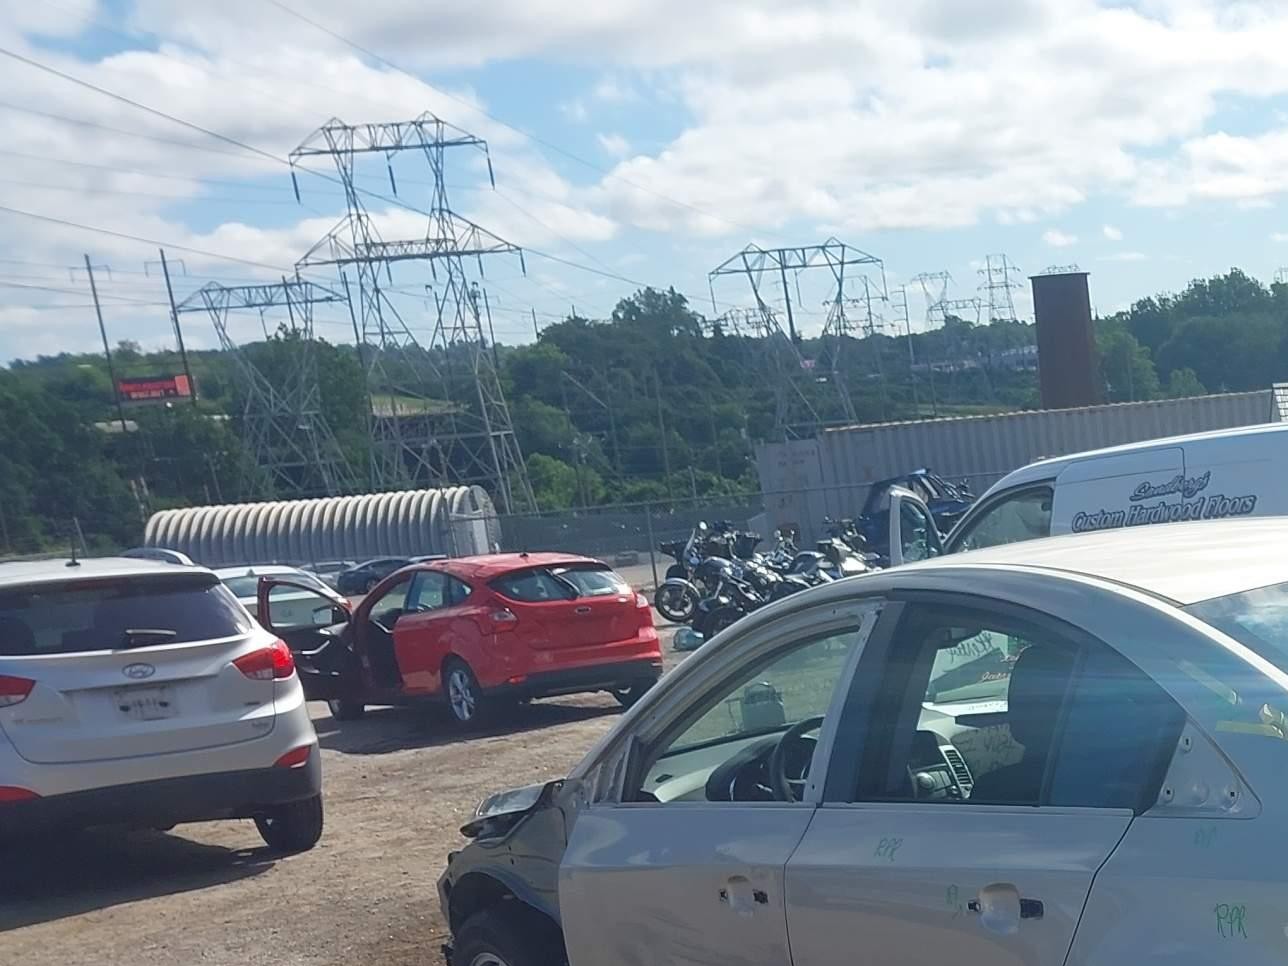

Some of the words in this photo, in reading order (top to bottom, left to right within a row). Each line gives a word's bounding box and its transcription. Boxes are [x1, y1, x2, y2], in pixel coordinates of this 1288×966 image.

[1072, 509, 1126, 533] Custom
[1125, 496, 1206, 525] Hardwood
[1204, 494, 1257, 519] Floors
